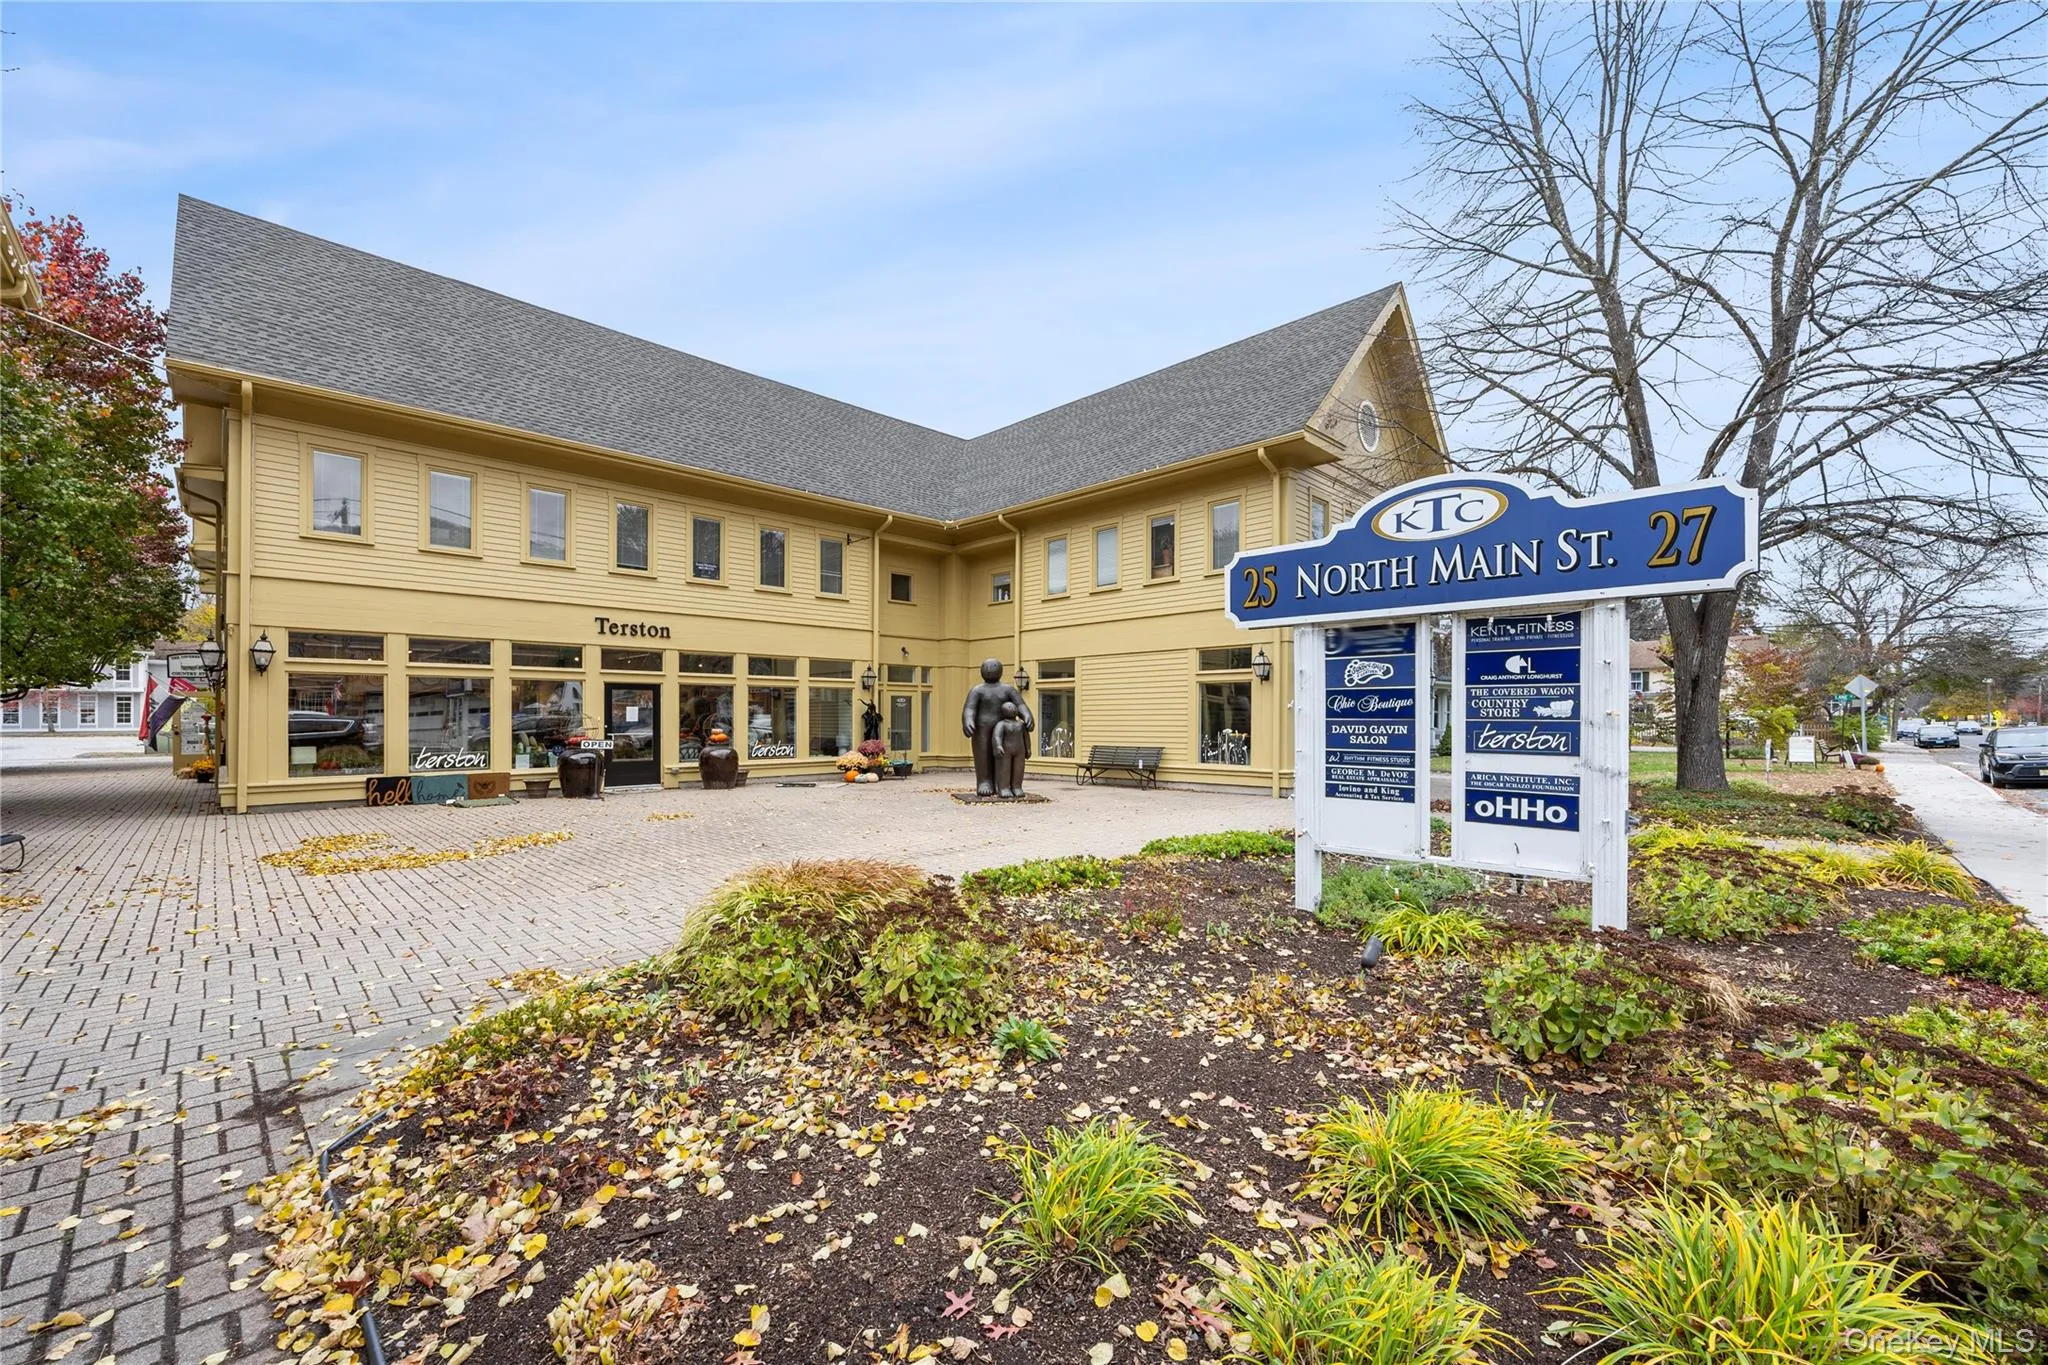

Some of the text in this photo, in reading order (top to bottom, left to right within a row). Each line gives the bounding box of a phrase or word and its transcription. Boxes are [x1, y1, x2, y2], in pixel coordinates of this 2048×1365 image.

[1394, 492, 1485, 535] KTC
[1243, 505, 1717, 608] 25 NORTH MAIN ST. 27
[595, 617, 671, 639] Terston
[1470, 621, 1574, 637] KENT FITNESS
[1492, 688, 1537, 696] COVERED
[1541, 687, 1575, 695] WAGON
[1327, 695, 1414, 713] Chic Boutique
[1471, 699, 1528, 708] COUNTRY
[1480, 708, 1520, 718] STORE
[1331, 725, 1408, 734] DAVID GAVIN
[1349, 736, 1388, 744] SALON
[1478, 723, 1568, 751] terston
[582, 740, 613, 749] OPEN
[752, 740, 794, 758] terston
[415, 746, 487, 769] terston
[1331, 768, 1365, 776] GEORGE
[1381, 770, 1409, 779] DeVOE
[1500, 775, 1551, 785] INSTITUTE,
[1554, 777, 1574, 786] INC.
[1381, 787, 1400, 796] King
